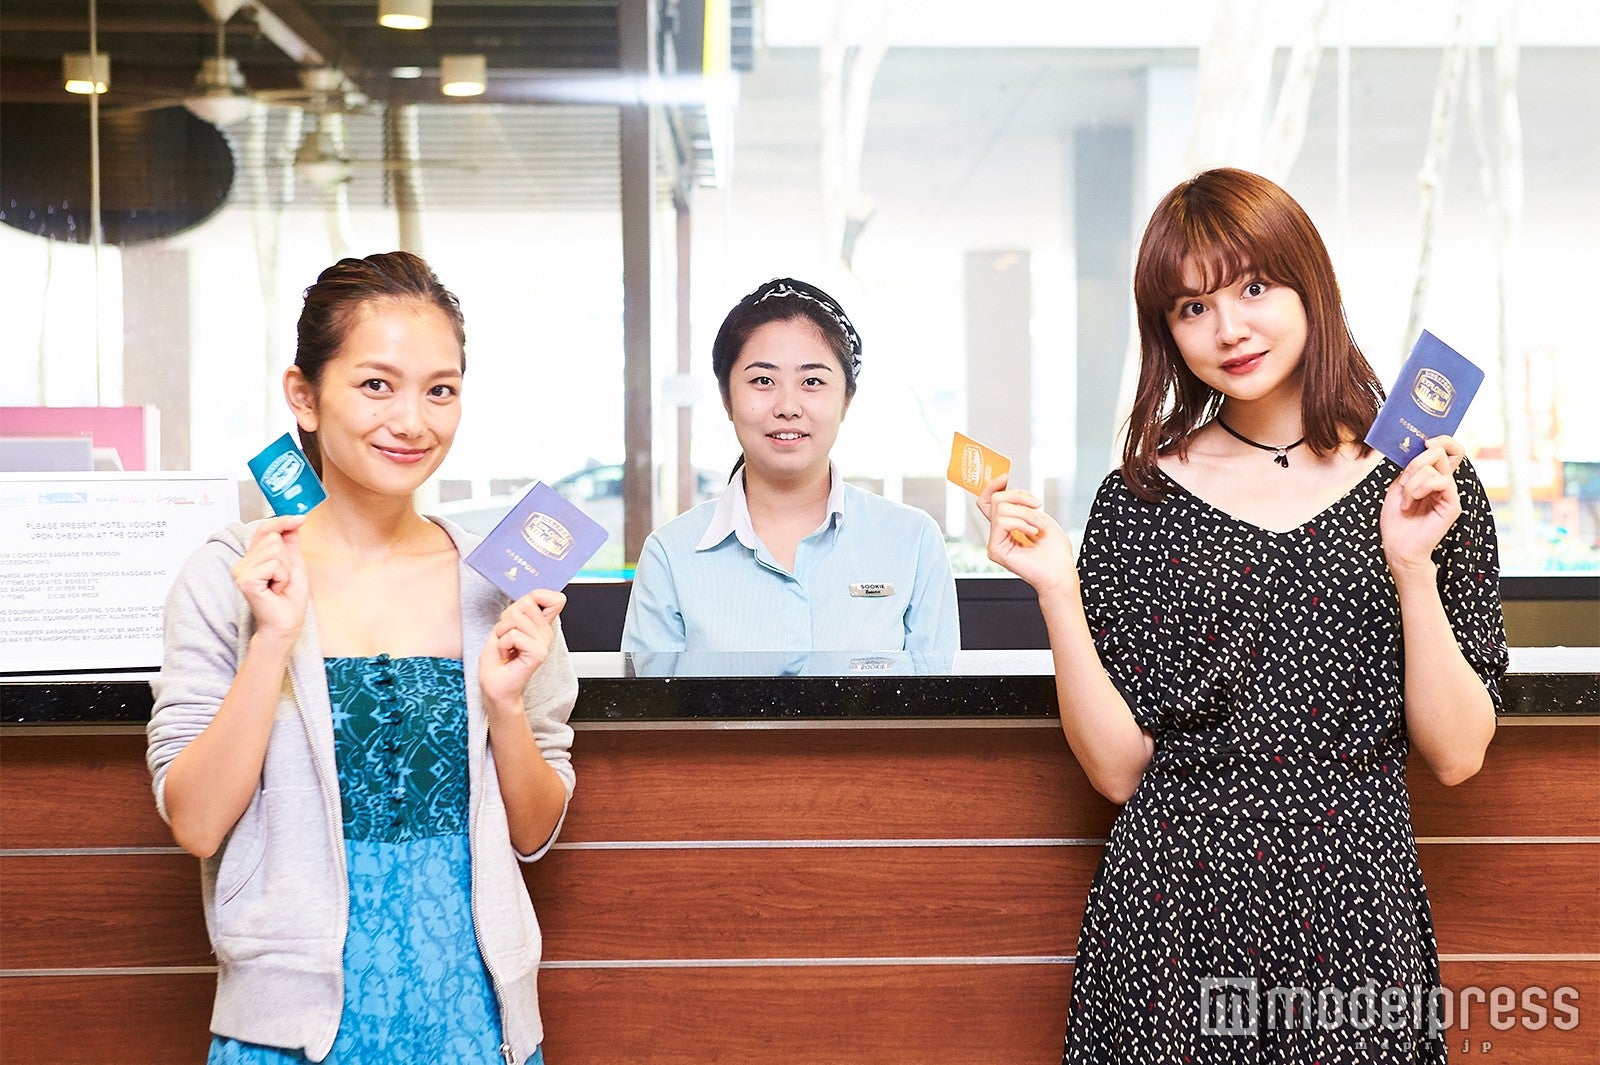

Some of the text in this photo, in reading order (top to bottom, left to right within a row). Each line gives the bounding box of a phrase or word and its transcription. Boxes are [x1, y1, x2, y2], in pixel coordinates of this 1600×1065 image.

[1399, 417, 1428, 441] PASSPOR
[26, 522, 58, 530] PLEASE
[100, 521, 126, 529] HOTEL
[129, 520, 168, 528] VOUCHER
[56, 532, 94, 540] CHECK-IN
[109, 531, 125, 539] THE
[127, 530, 166, 539] COUNTER
[504, 548, 540, 577] PASSPORT
